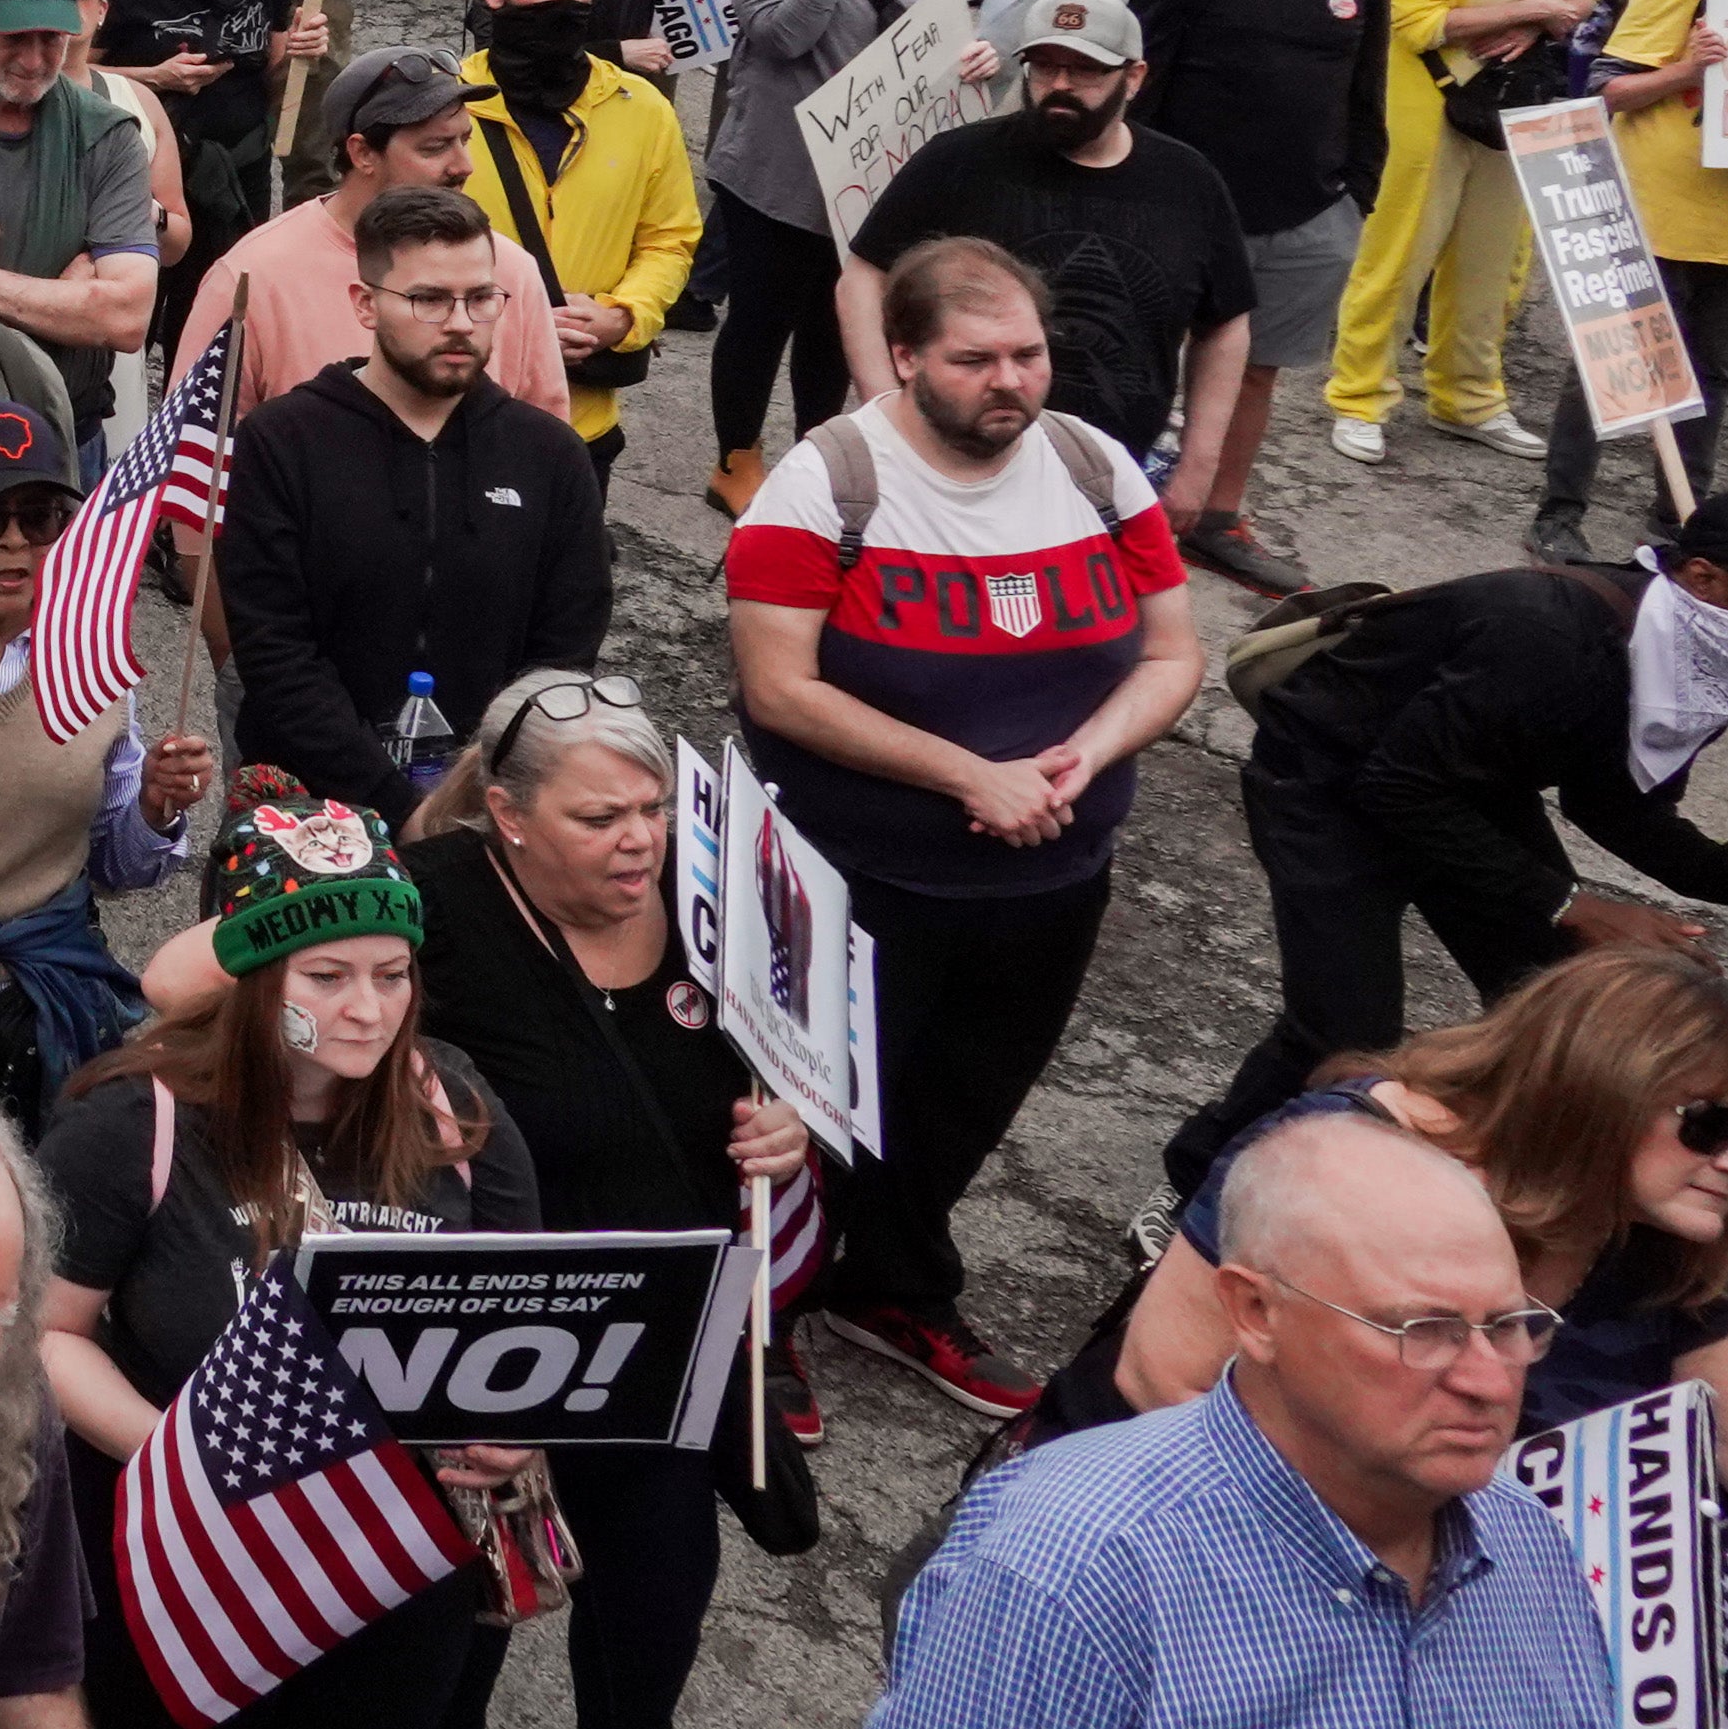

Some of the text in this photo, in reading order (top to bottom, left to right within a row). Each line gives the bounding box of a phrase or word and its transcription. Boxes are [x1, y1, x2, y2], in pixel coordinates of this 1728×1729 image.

[1557, 150, 1593, 176] The
[1541, 178, 1623, 222] Trump
[1550, 210, 1641, 266] Fascist
[1563, 255, 1655, 310] Regime
[242, 889, 360, 955] MEOWY
[331, 1296, 611, 1314] ENOUGH OF US SAY
[339, 1272, 646, 1291] THIS ALL ENDS WHEN
[338, 1323, 647, 1413] NO!
[1629, 1395, 1679, 1655] HANDS
